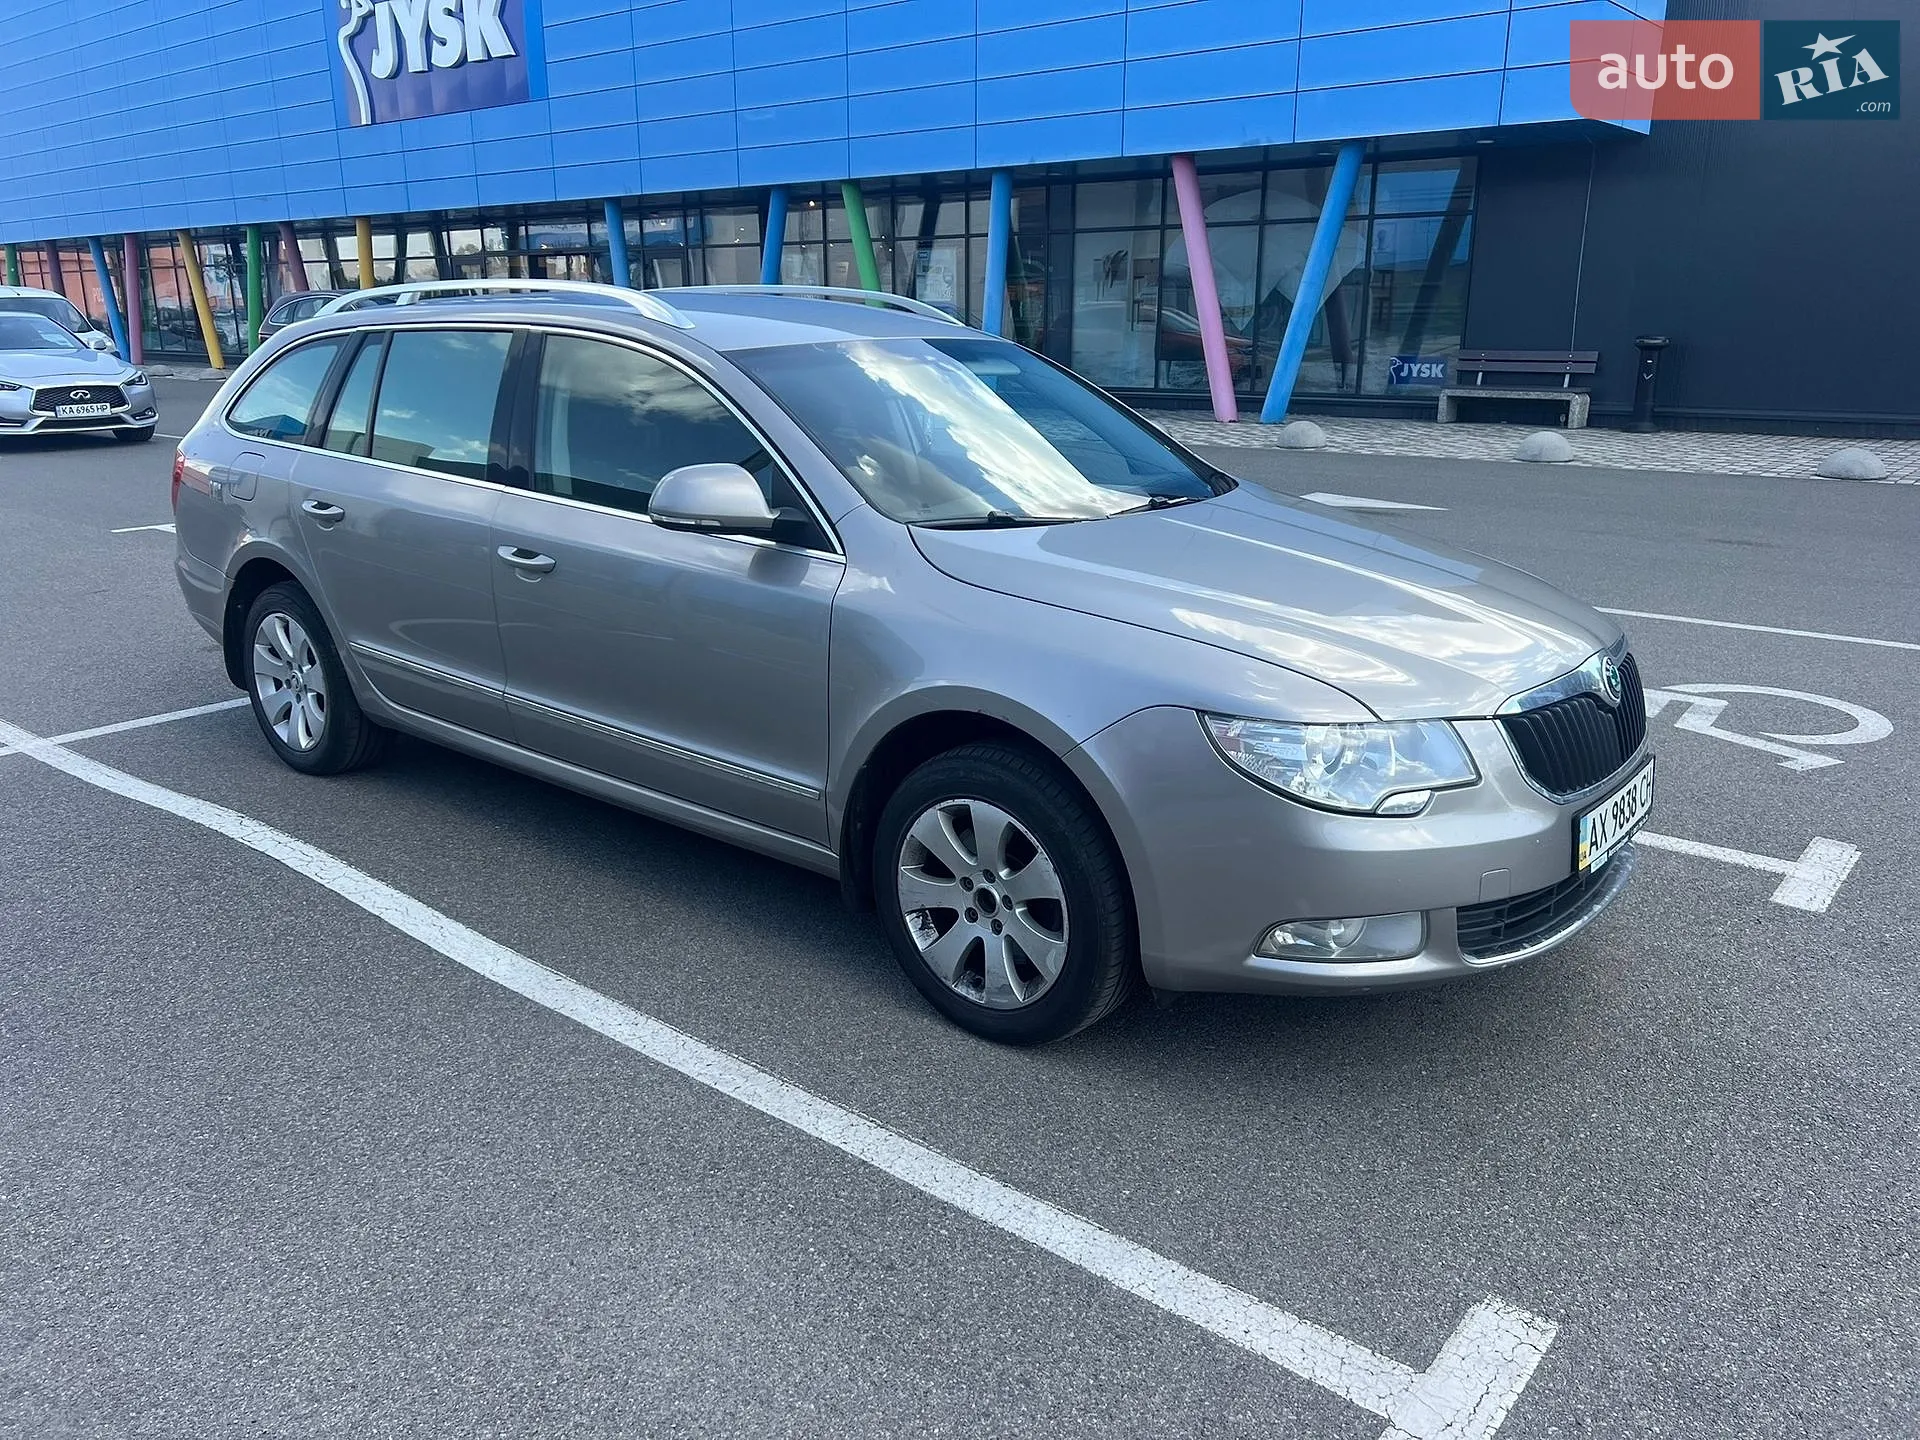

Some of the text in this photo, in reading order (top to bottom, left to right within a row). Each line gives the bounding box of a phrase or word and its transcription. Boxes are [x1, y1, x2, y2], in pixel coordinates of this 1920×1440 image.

[371, 0, 517, 79] JYSK
[1400, 363, 1444, 378] JYSK
[61, 407, 75, 415] KA
[76, 405, 95, 414] 6965
[1589, 767, 1652, 857] AX 9838 CH
